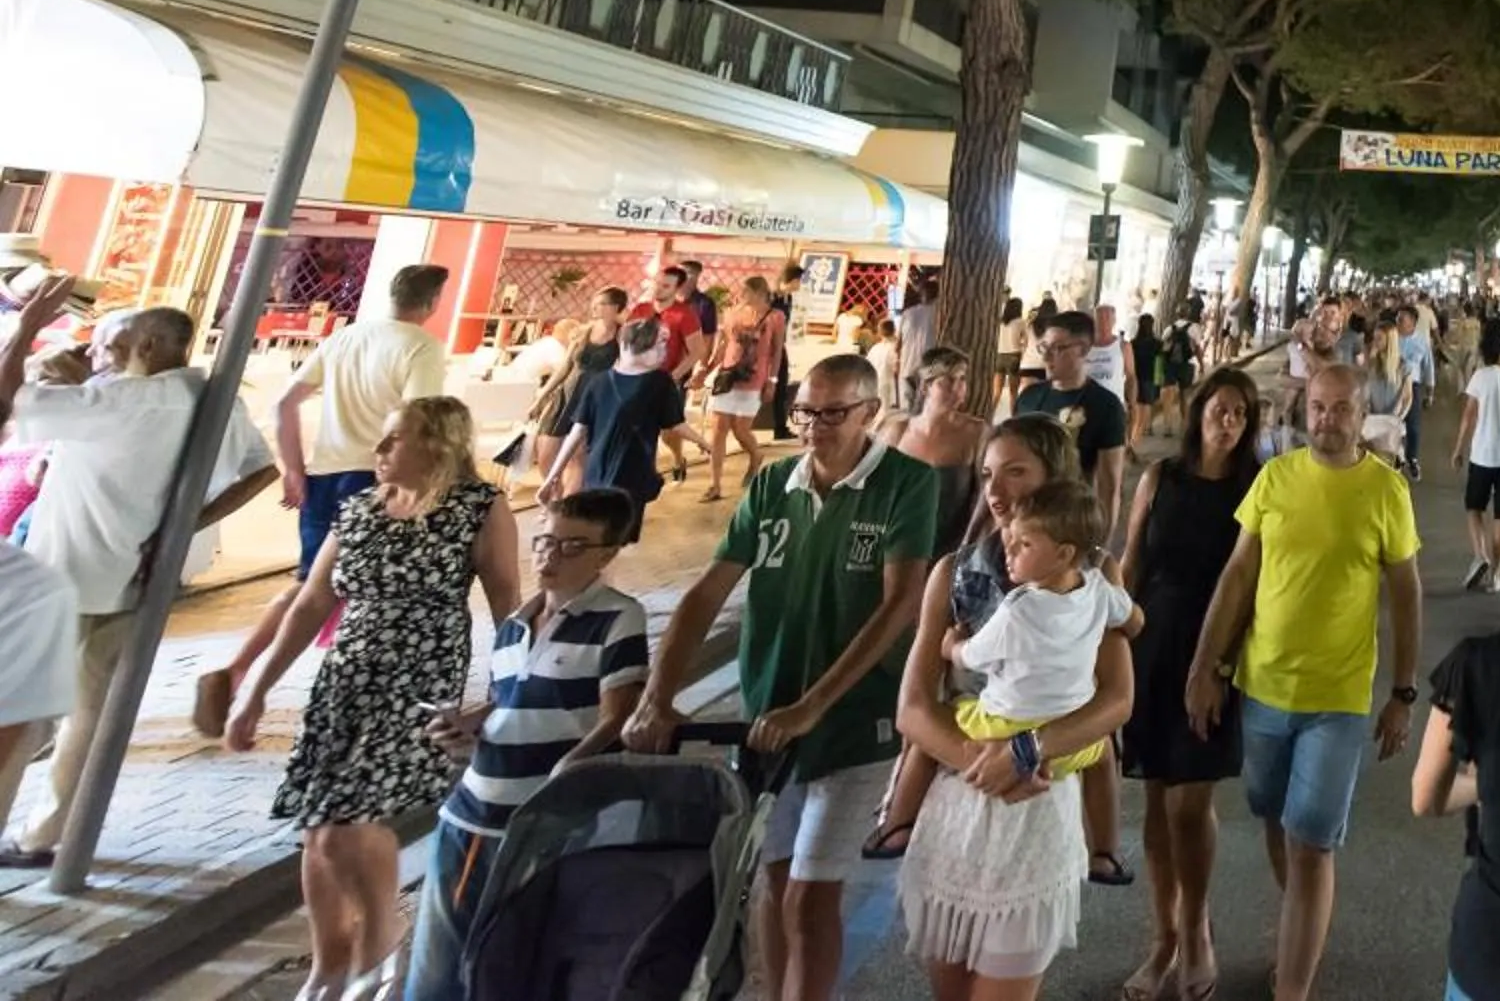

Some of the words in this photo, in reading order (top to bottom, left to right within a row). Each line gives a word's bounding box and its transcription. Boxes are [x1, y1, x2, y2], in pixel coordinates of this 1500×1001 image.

[1385, 148, 1448, 169] LUNA
[616, 199, 652, 219] Bar
[738, 210, 805, 232] Gelateria
[752, 518, 791, 568] 52
